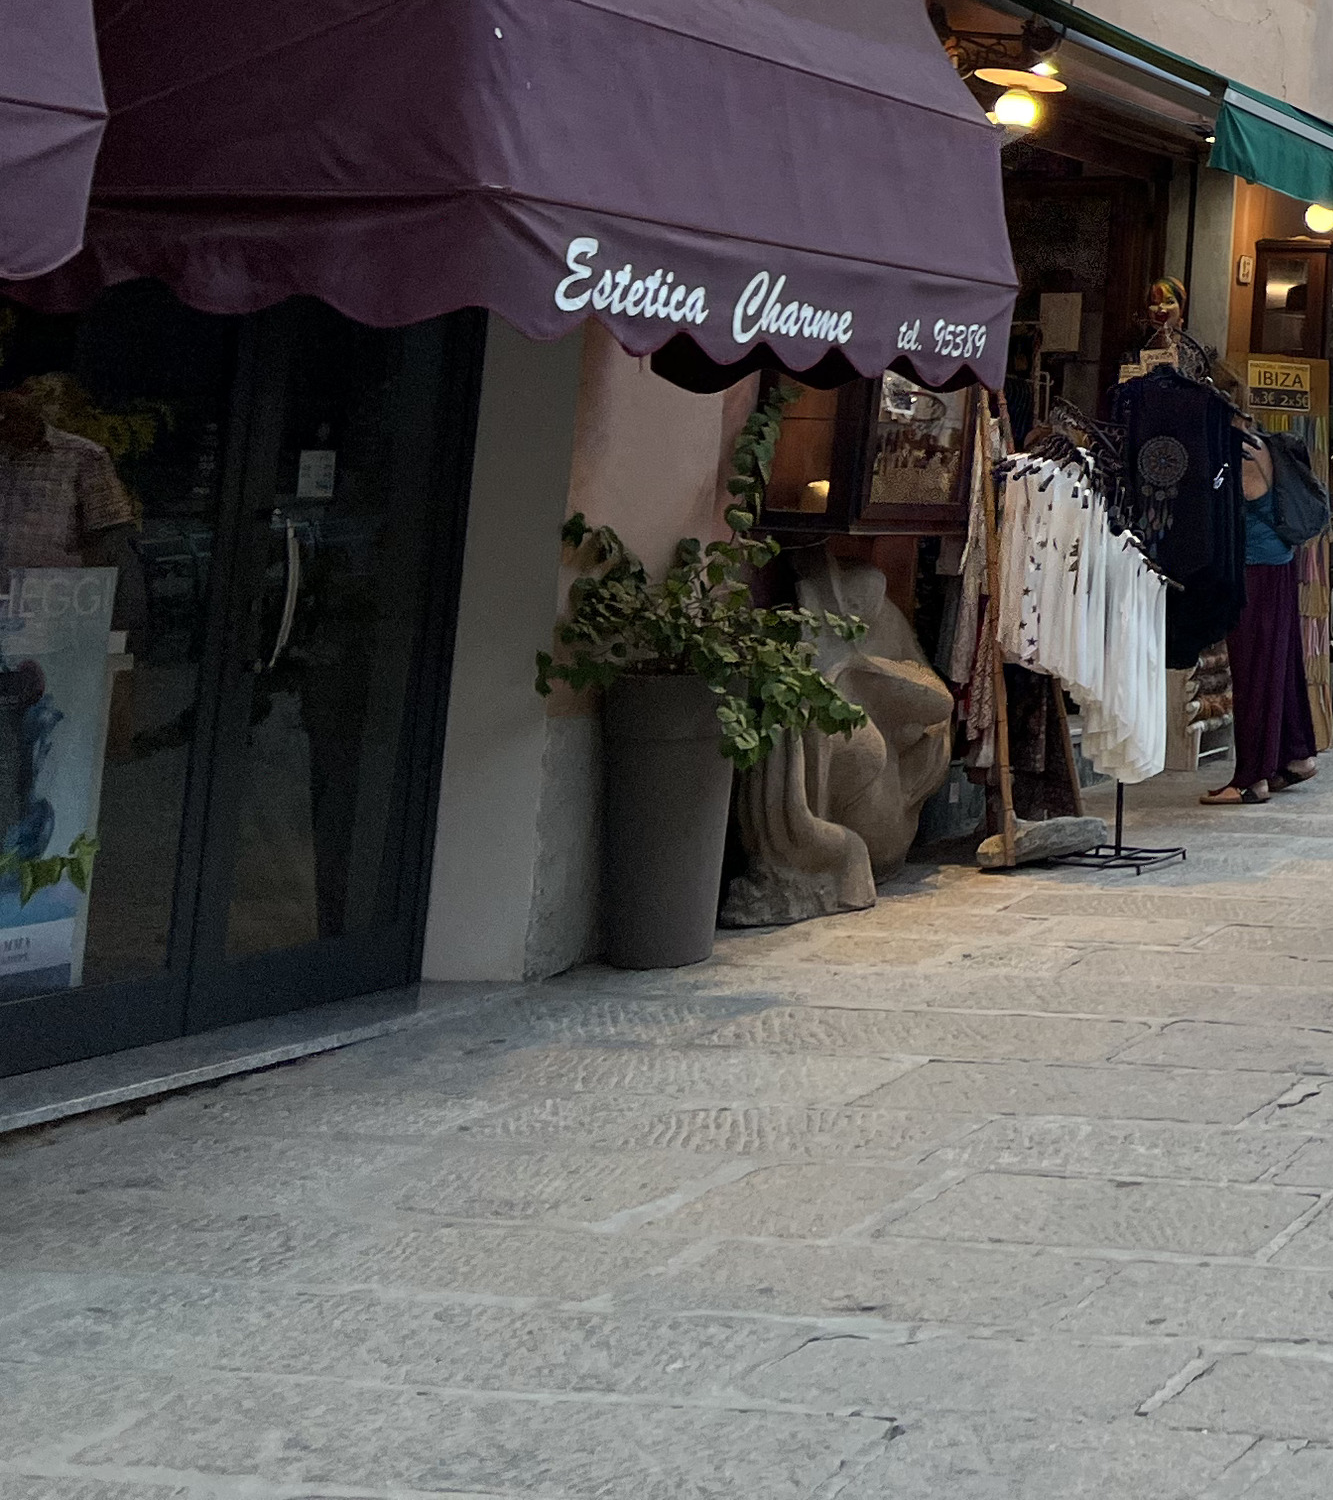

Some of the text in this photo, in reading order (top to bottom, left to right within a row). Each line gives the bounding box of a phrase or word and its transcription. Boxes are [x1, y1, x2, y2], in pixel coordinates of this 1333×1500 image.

[555, 237, 987, 359] Estetica Charme tel. 95389
[1258, 369, 1303, 388] IBIZA
